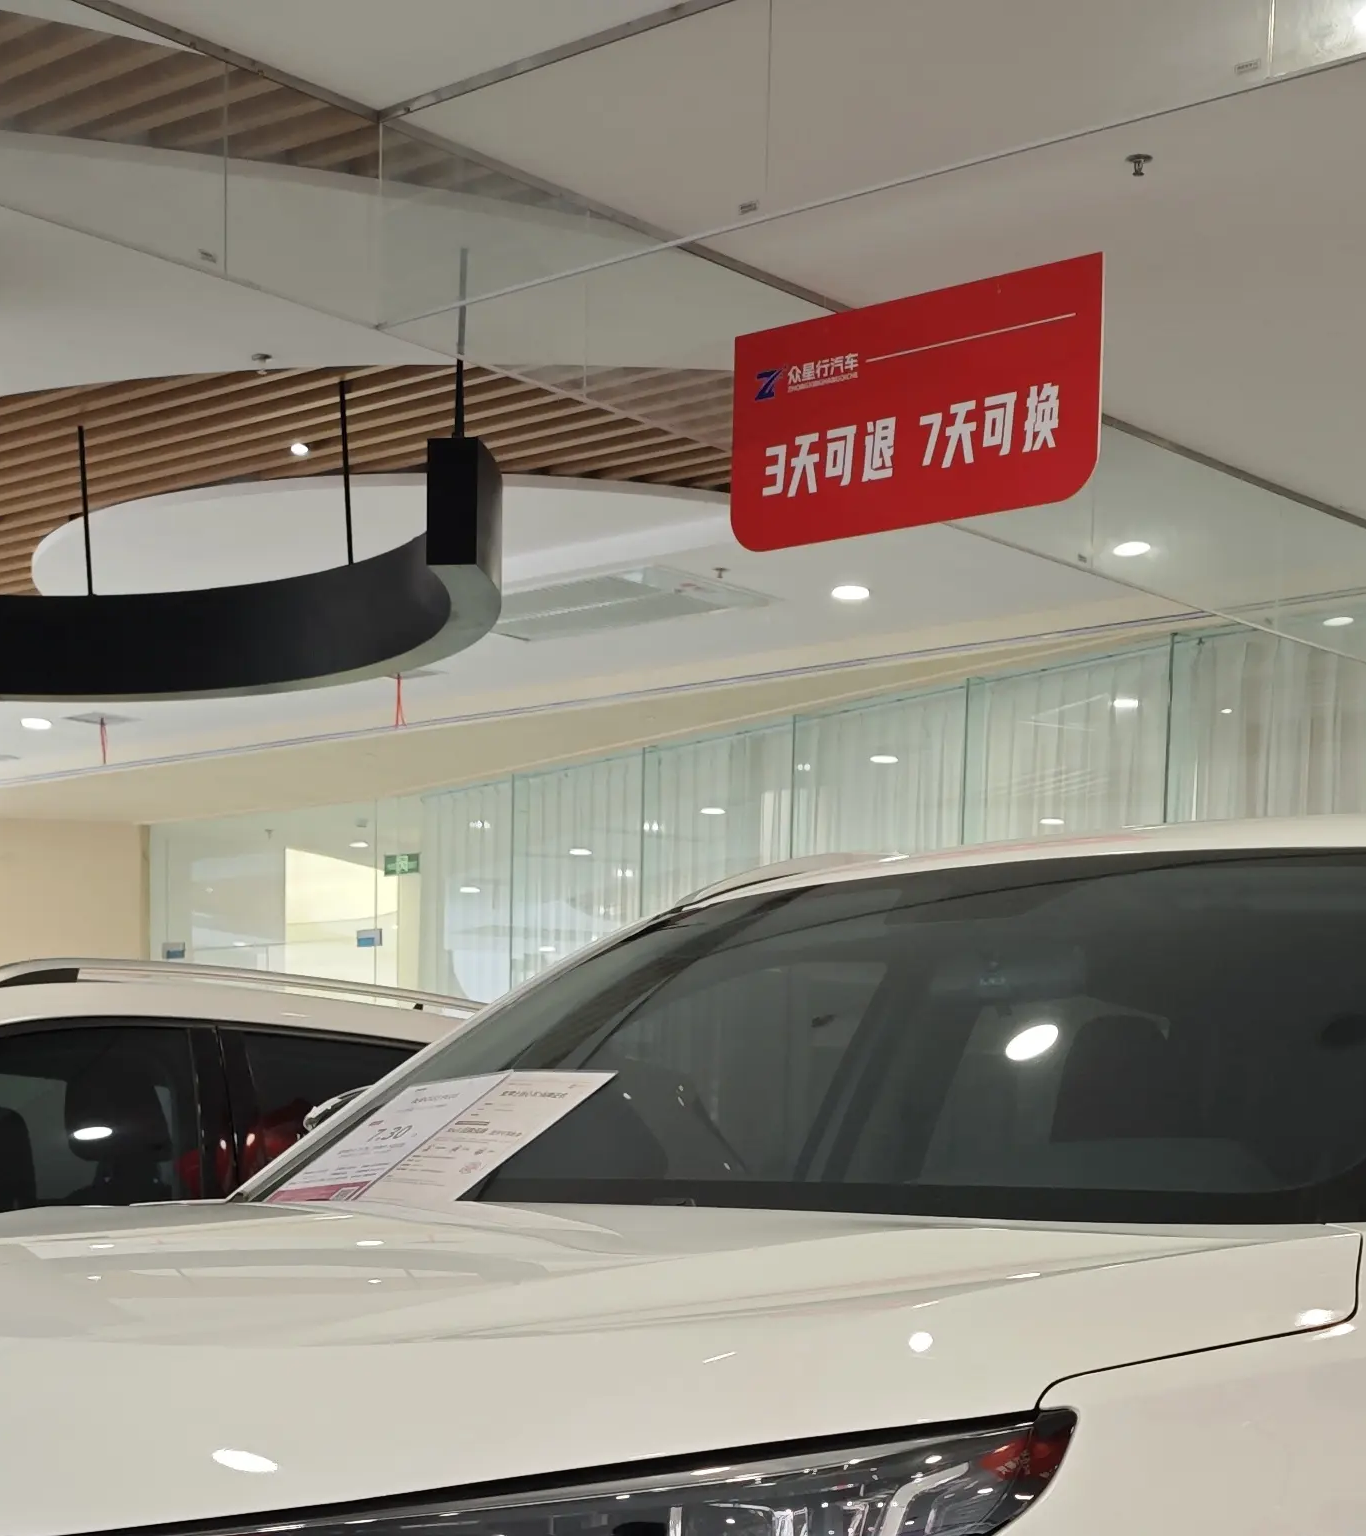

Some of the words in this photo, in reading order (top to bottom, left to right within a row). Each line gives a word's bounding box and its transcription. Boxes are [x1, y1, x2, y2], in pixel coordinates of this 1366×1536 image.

[787, 353, 859, 385] 众星行汽车
[762, 416, 897, 498] 3天可退
[919, 382, 1060, 469] 7天可换
